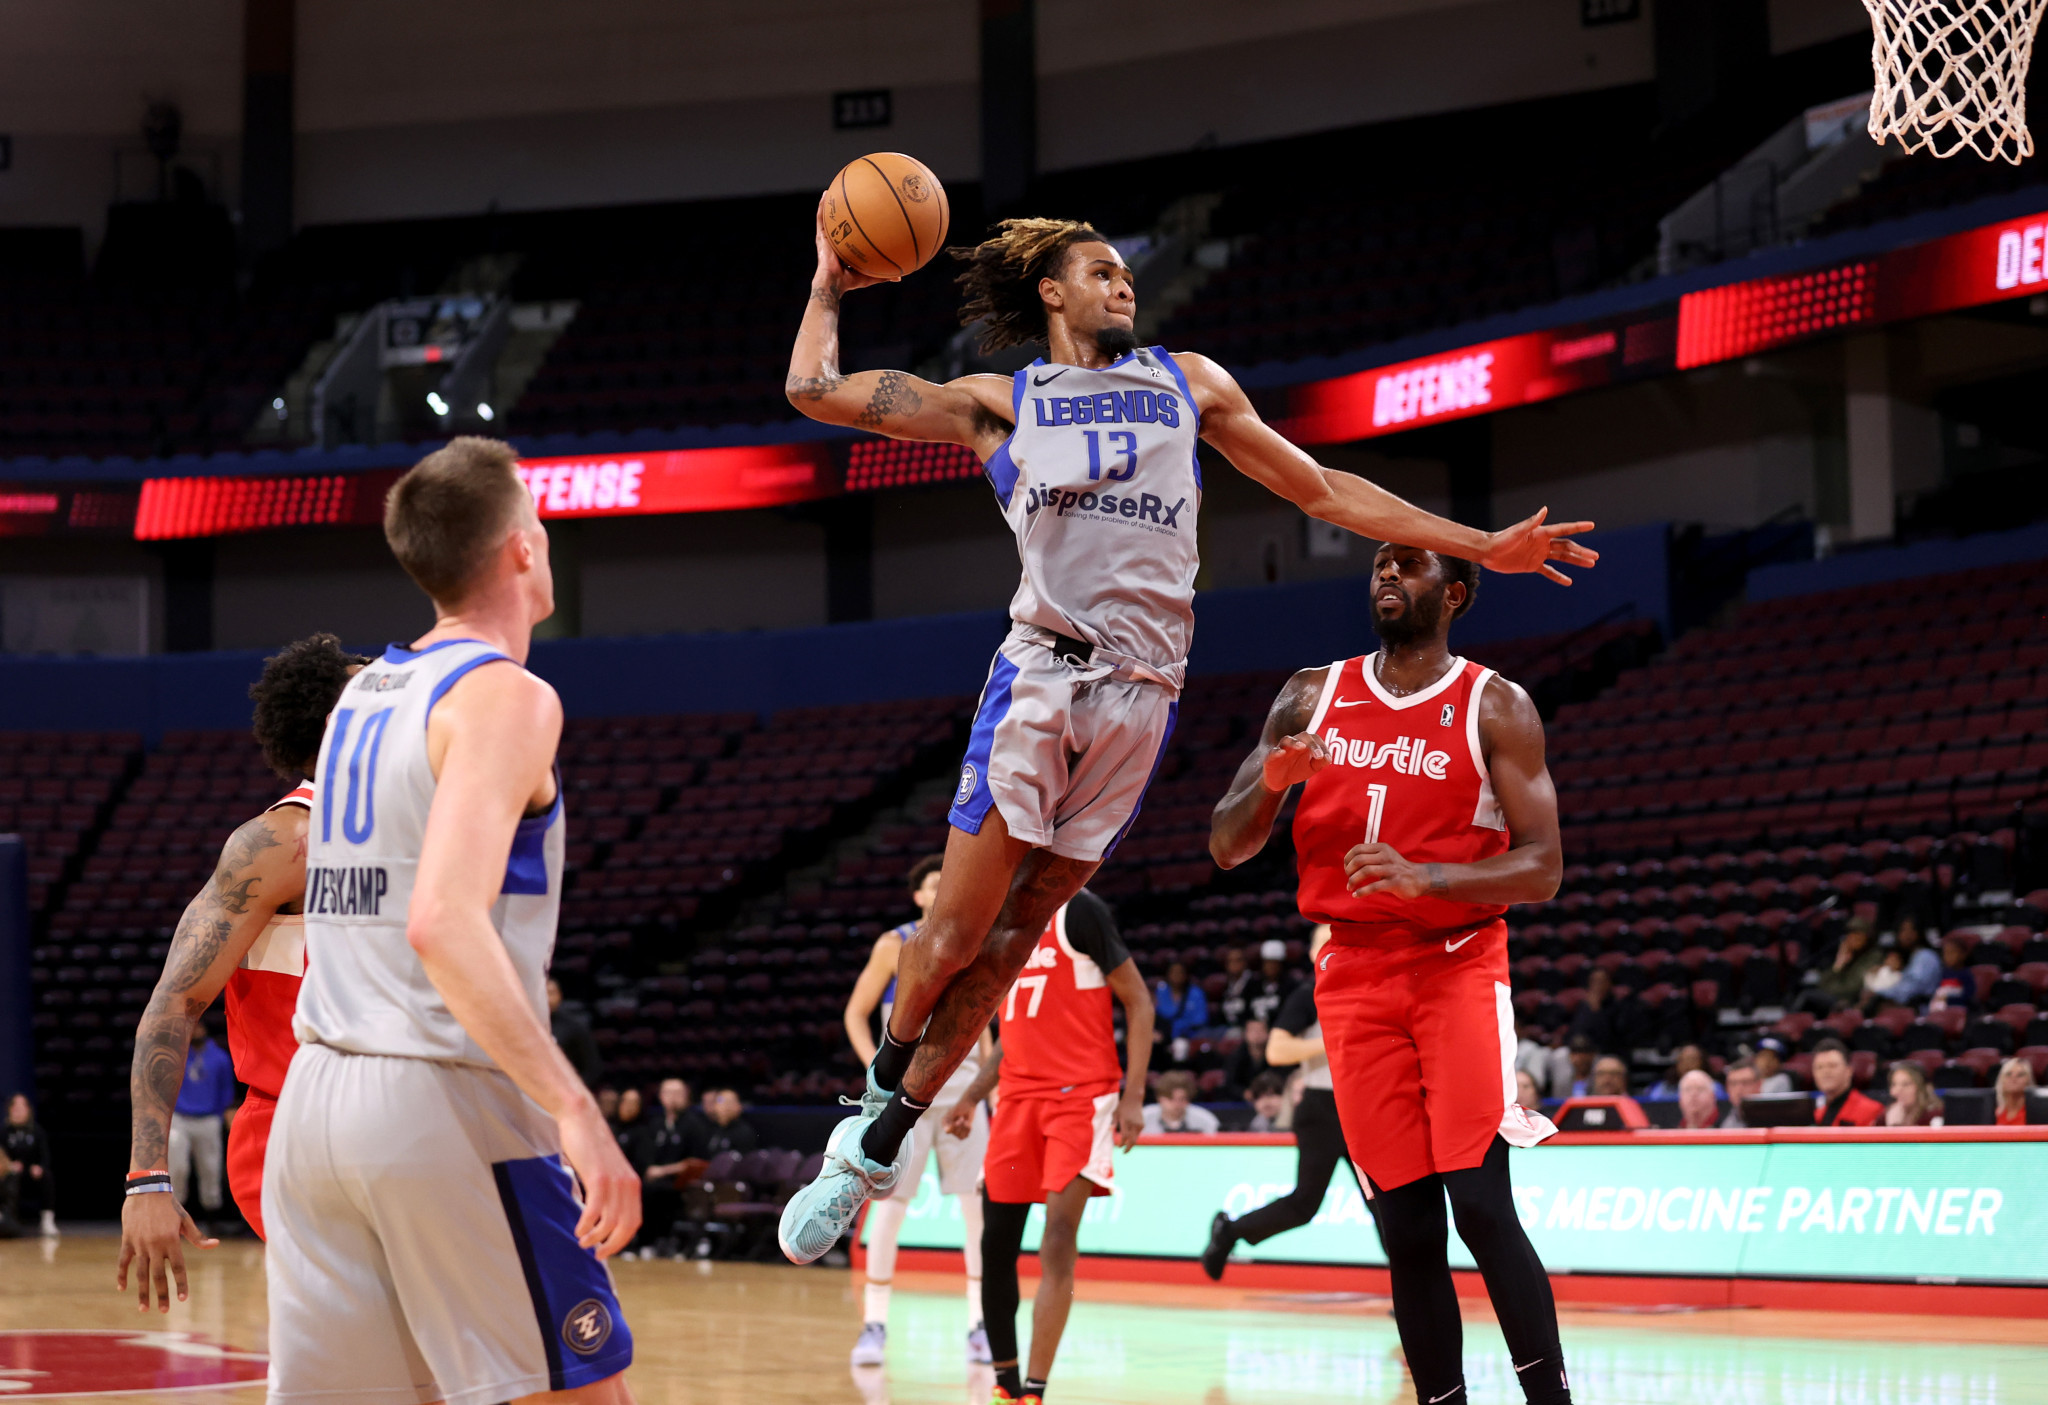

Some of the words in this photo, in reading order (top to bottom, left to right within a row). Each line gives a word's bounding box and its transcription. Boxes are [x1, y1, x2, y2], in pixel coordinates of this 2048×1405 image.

[1996, 224, 2048, 290] DE
[1031, 390, 1180, 429] LEGENDS
[1372, 352, 1494, 427] DEFENSE
[1082, 430, 1138, 482] 13
[1064, 510, 1088, 520] Solving
[1101, 515, 1129, 526] problem
[1139, 522, 1154, 532] drug
[321, 707, 395, 845] 10
[1324, 727, 1452, 780] hustle
[1364, 783, 1388, 844] 1
[1545, 1186, 1773, 1232] MEDICINE
[1776, 1186, 2004, 1236] PARTNER
